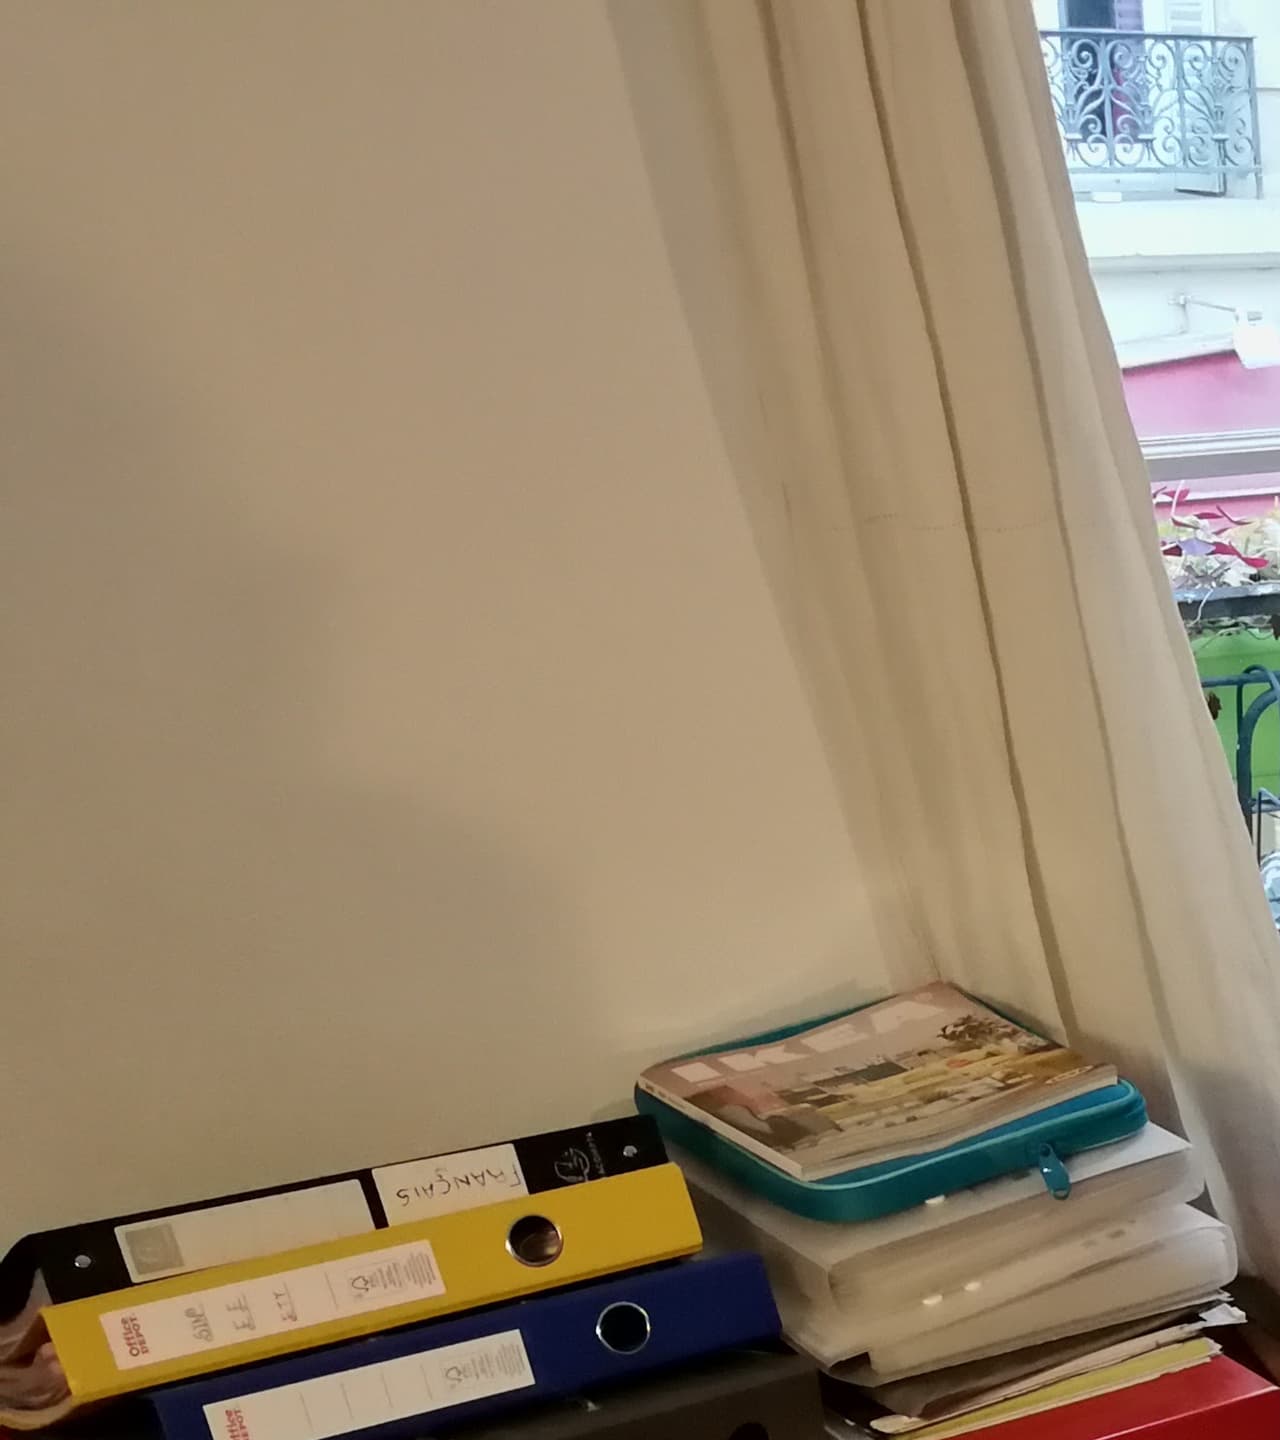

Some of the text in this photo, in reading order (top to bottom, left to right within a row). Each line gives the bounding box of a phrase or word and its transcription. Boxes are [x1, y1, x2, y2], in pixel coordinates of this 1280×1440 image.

[672, 999, 946, 1083] IKEA
[396, 1164, 522, 1207] FRANÇAIS
[120, 1316, 140, 1358] Office
[129, 1315, 150, 1355] DEPOT
